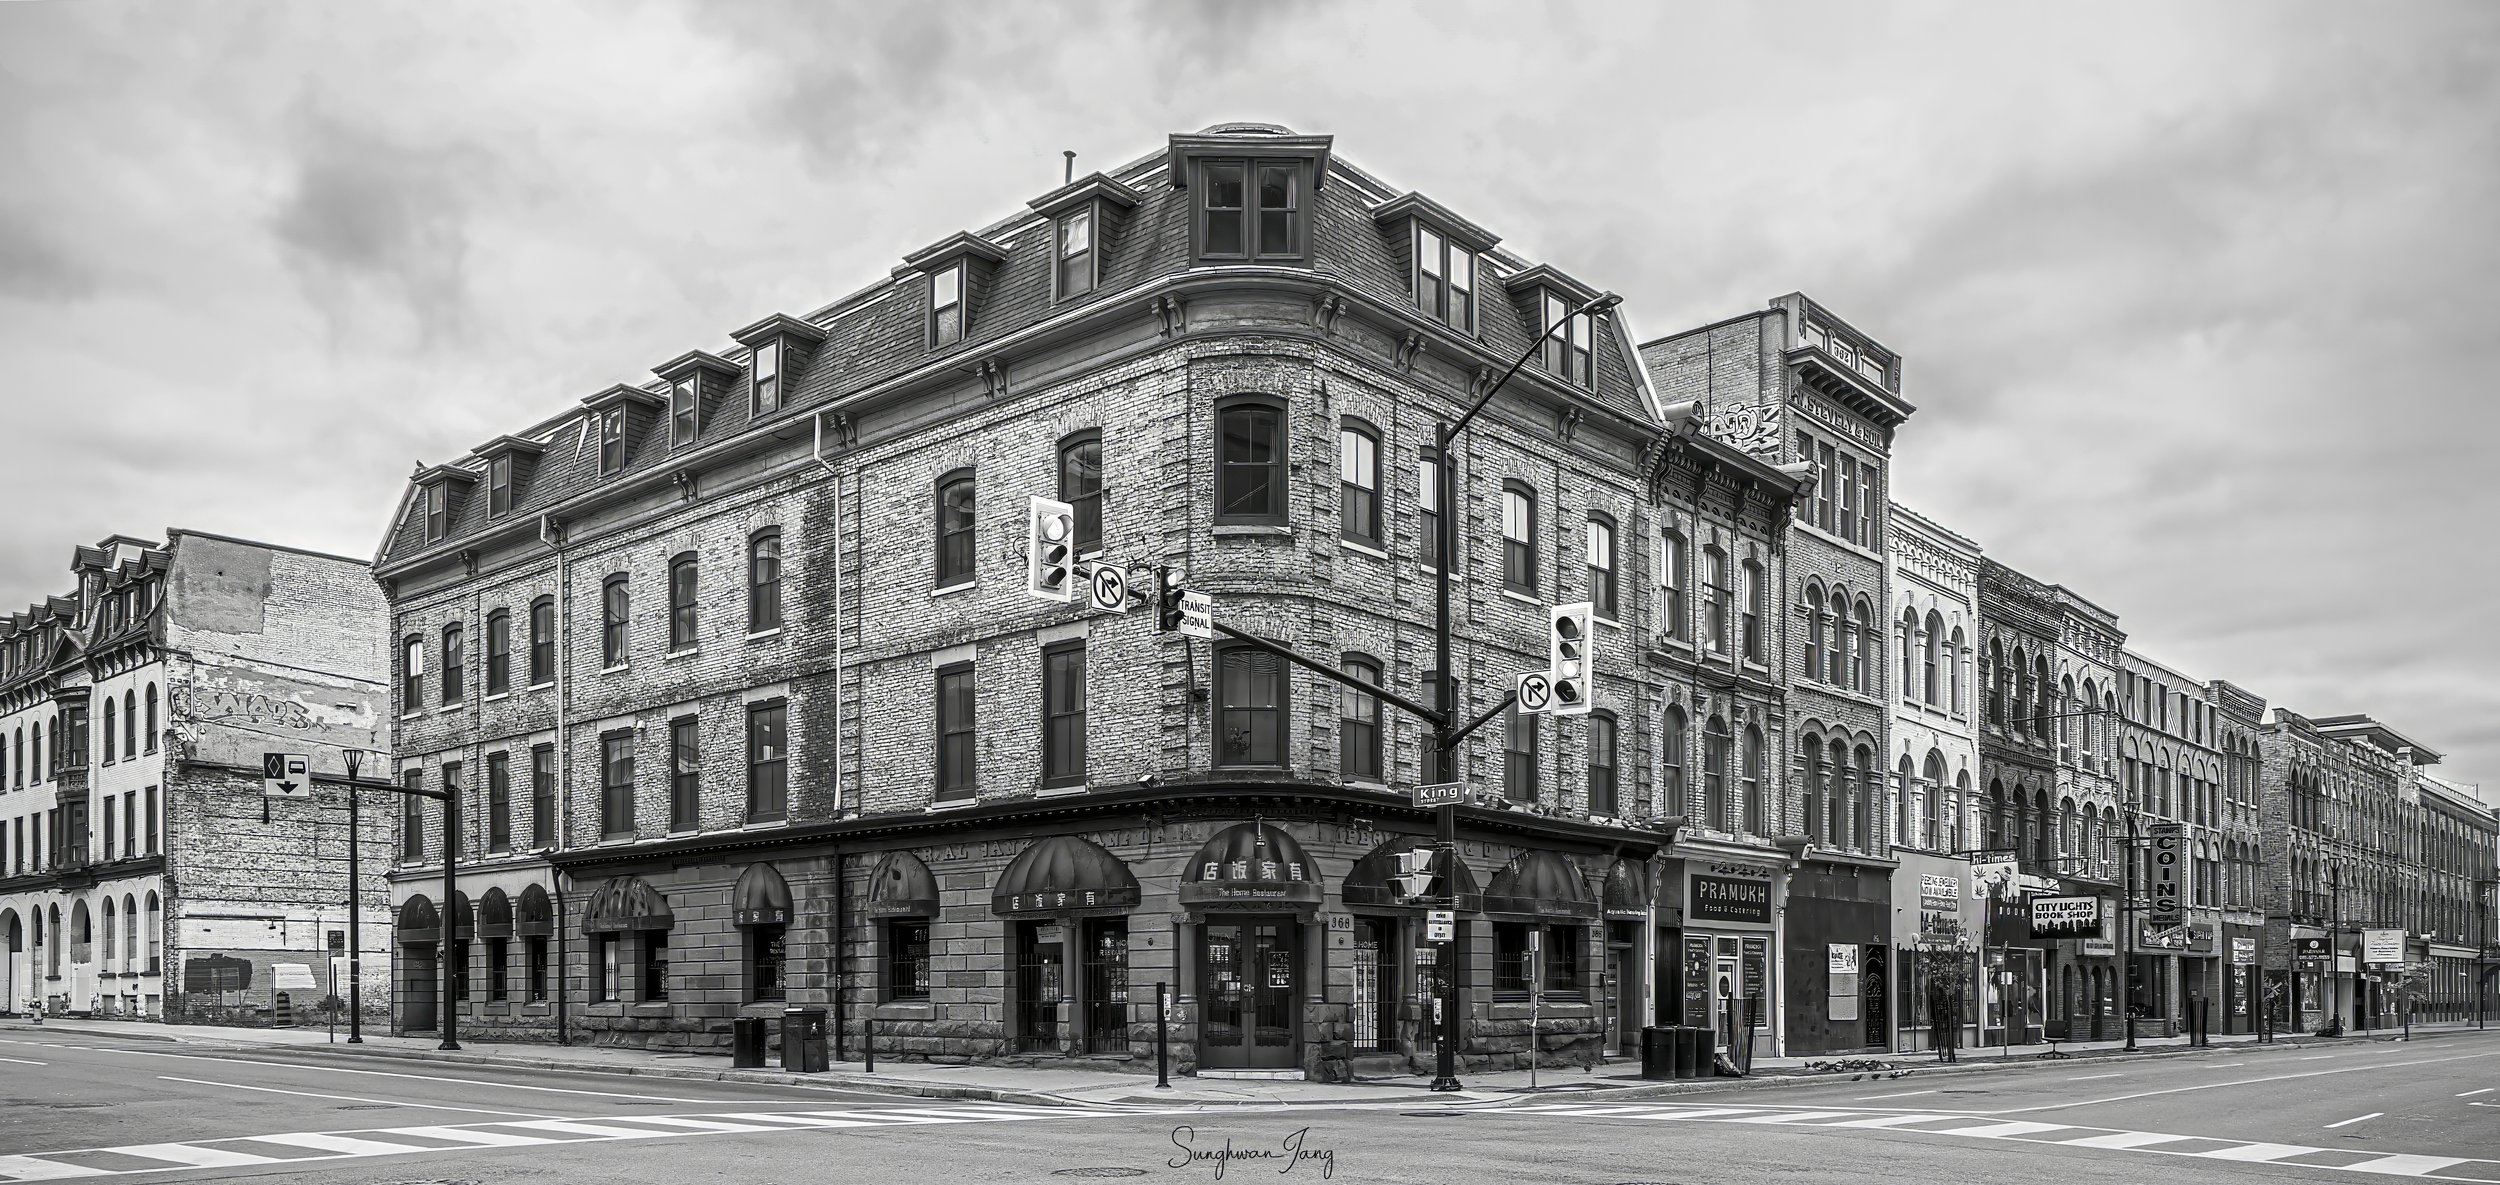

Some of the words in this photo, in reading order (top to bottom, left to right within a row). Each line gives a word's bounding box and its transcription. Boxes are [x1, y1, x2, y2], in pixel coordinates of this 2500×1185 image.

[1181, 600, 1210, 615] TRANSIT
[1182, 614, 1210, 630] SIGNAL
[1420, 787, 1458, 799] King
[2153, 826, 2180, 835] STAMPS
[1972, 853, 2015, 865] hi-times
[2155, 836, 2178, 913] COINS
[1219, 888, 1230, 897] The
[1231, 887, 1250, 897] Home
[1700, 880, 1765, 903] PRAMUKH
[1704, 904, 1722, 912] Food
[1730, 906, 1761, 917] Catering
[2035, 902, 2057, 911] CITY
[2059, 901, 2093, 911] LIGHTS
[2067, 911, 2094, 919] SHOP
[1331, 917, 1350, 929] 368
[1359, 941, 1378, 949] HOME
